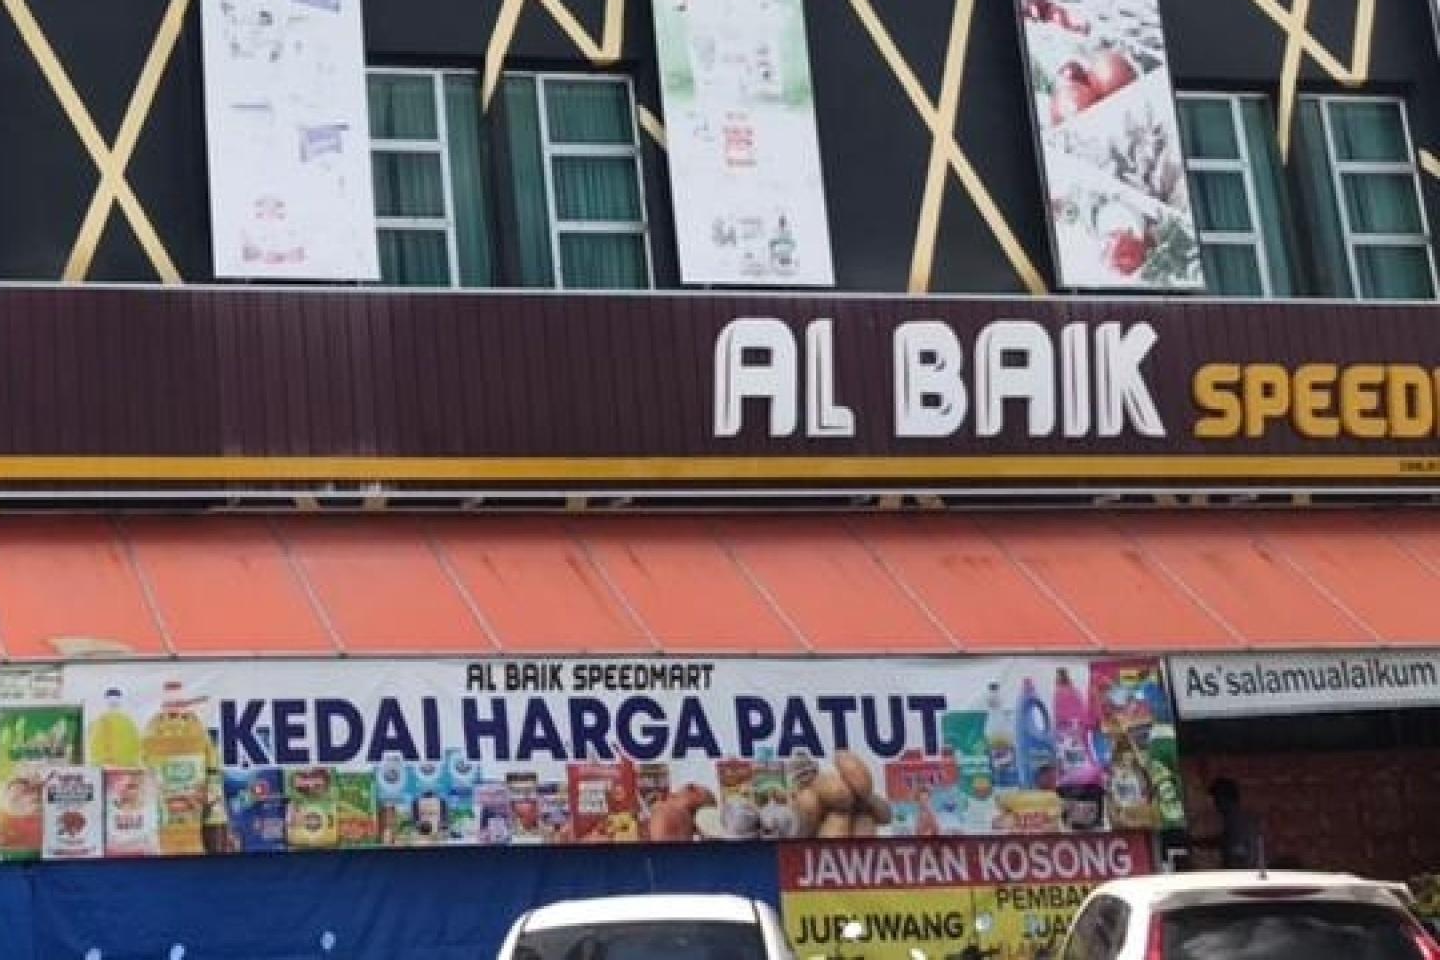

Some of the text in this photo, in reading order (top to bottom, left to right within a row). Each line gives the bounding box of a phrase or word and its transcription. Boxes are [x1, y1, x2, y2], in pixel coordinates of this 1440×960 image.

[714, 317, 1440, 439] AL BAIK SPEED
[465, 662, 716, 691] AL BAIK SPEEDMART
[220, 694, 948, 767] KEDAI HARGA PATUT
[799, 836, 1133, 888] JAWATAN KOSONG
